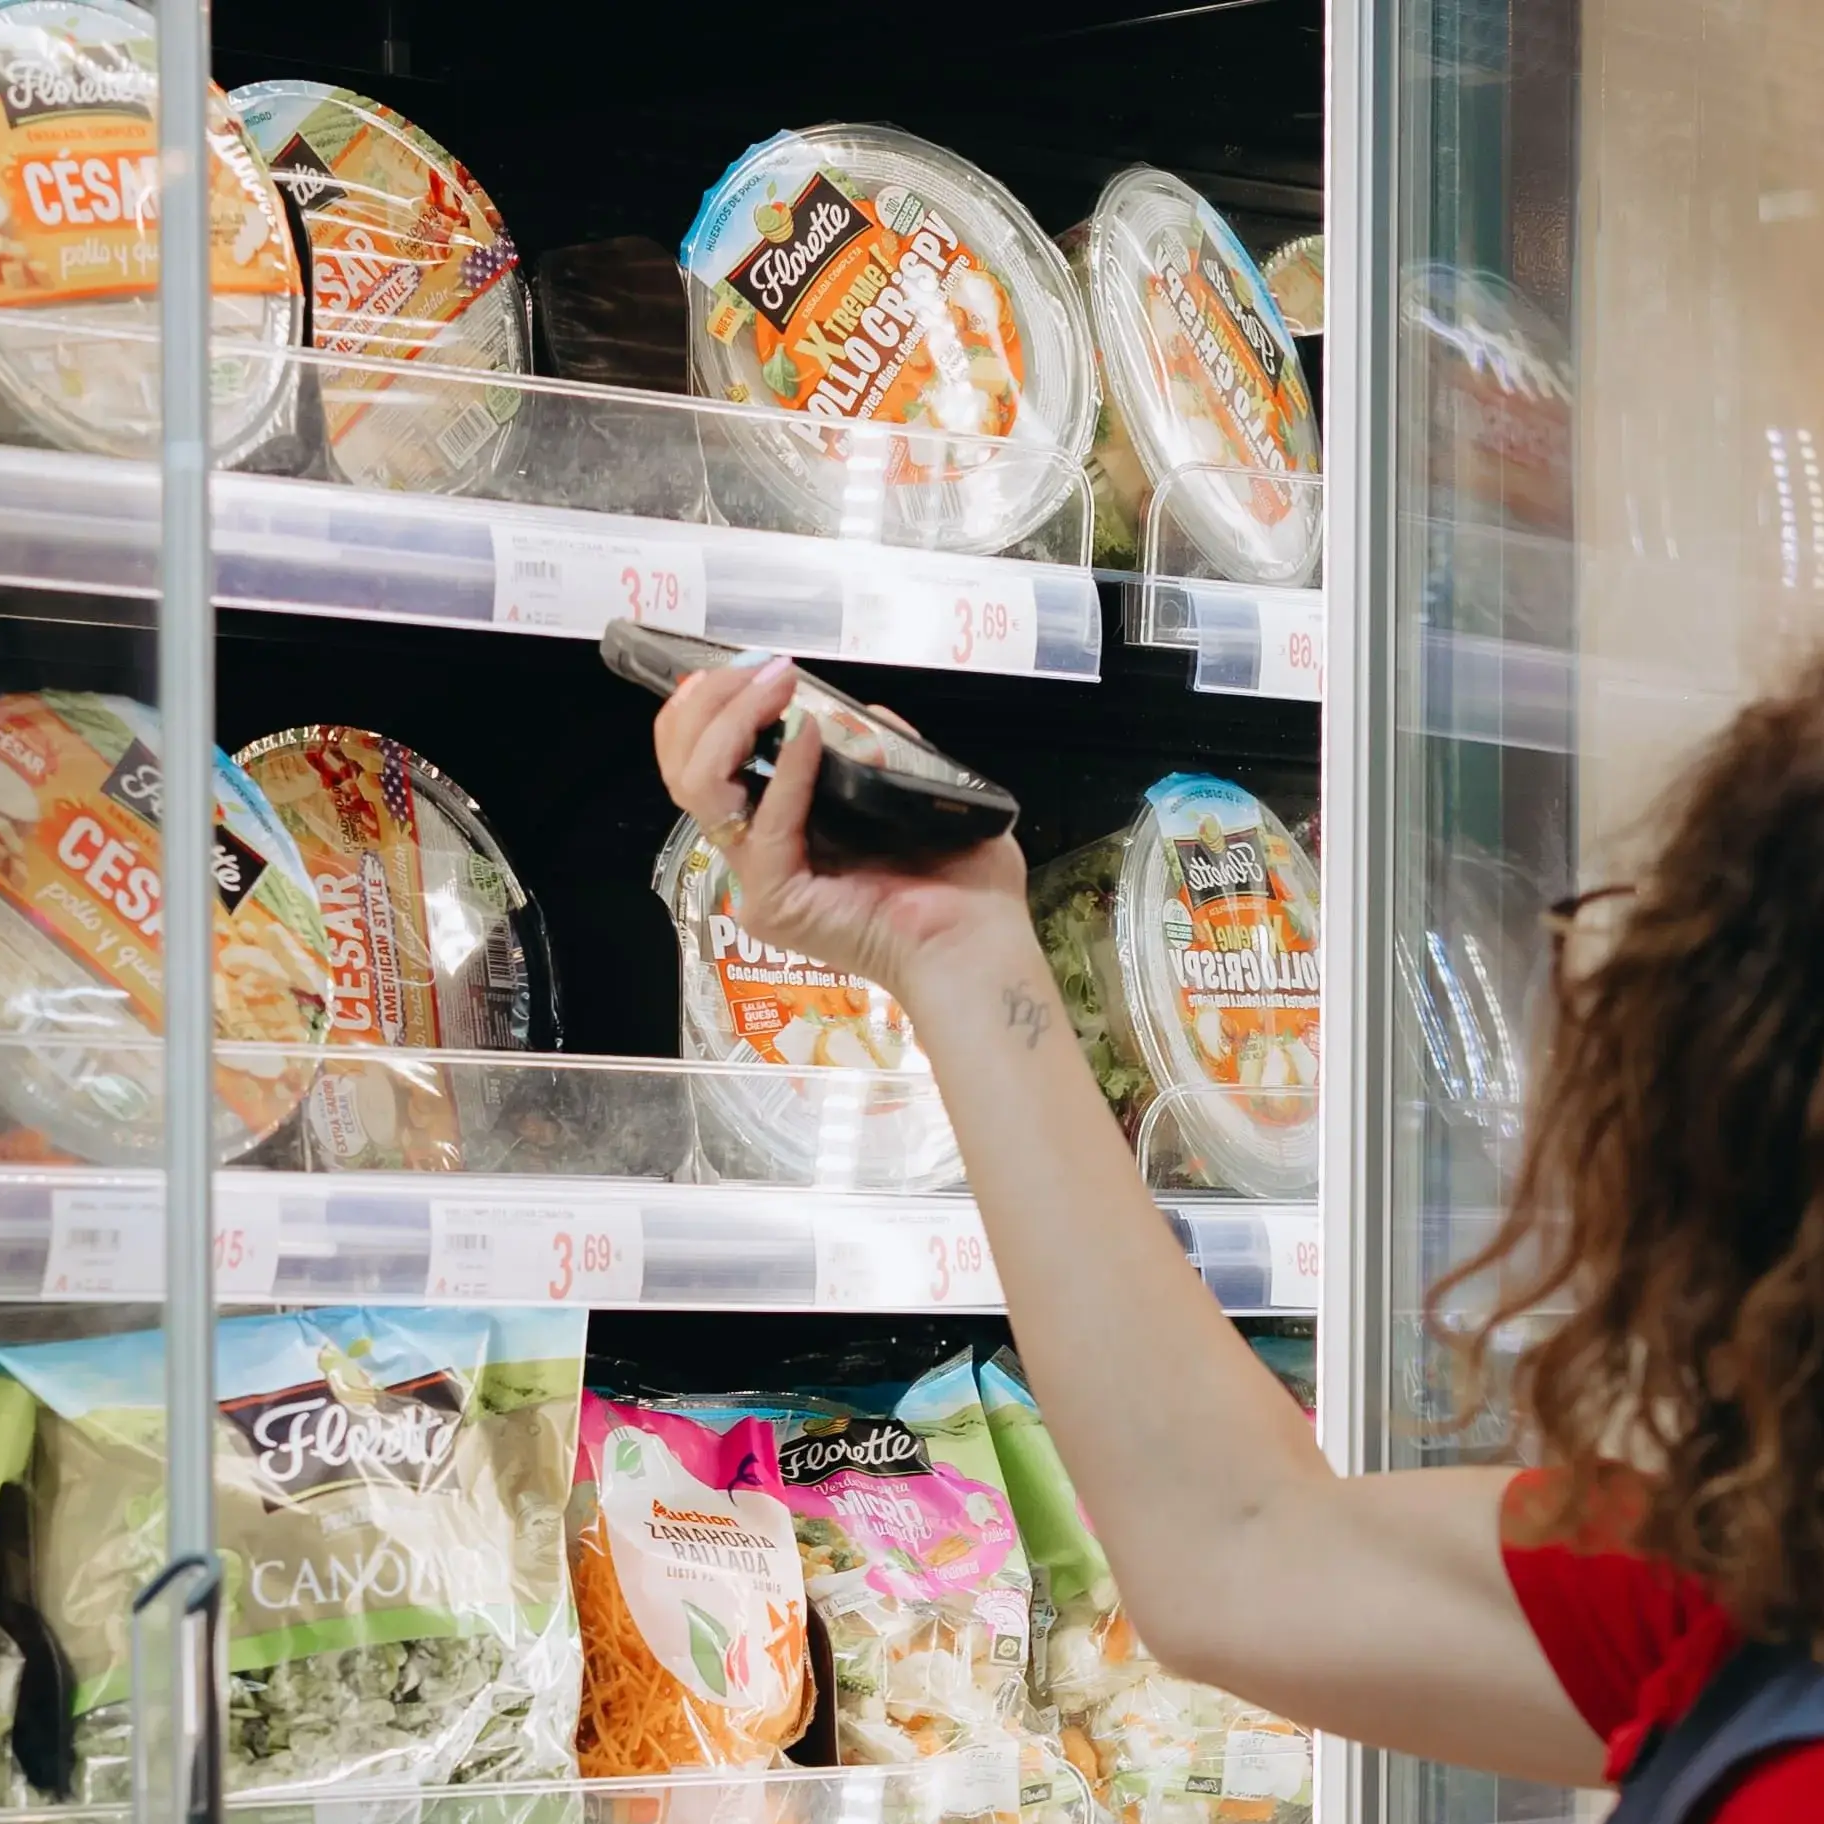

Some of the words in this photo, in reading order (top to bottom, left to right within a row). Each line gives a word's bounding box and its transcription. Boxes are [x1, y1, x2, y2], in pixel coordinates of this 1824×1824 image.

[23, 151, 161, 228] CÉSA
[706, 206, 732, 252] HUERTOS
[749, 201, 851, 311] Florette
[314, 228, 392, 310] SAR
[375, 275, 409, 316] STYLE
[715, 306, 737, 338] NUEVO
[789, 336, 882, 454] POLLO
[621, 566, 679, 621] 3.79
[952, 596, 1008, 665] 3.69
[37, 880, 93, 931] pollo
[368, 875, 385, 930] STYLE
[373, 935, 399, 1026] AMERICAN
[744, 1010, 779, 1022] QUESO
[744, 1019, 784, 1033] CREMOSA
[335, 1114, 351, 1156] EXTRA
[549, 1231, 612, 1300] 3.69
[929, 1235, 982, 1303] 3.69
[255, 1397, 457, 1482] Florette
[778, 1425, 919, 1480] Florette
[652, 1499, 740, 1528] Auchan
[827, 1488, 924, 1527] MICRO
[643, 1520, 777, 1551] ZANAHORIA
[671, 1541, 771, 1578] RALLADA
